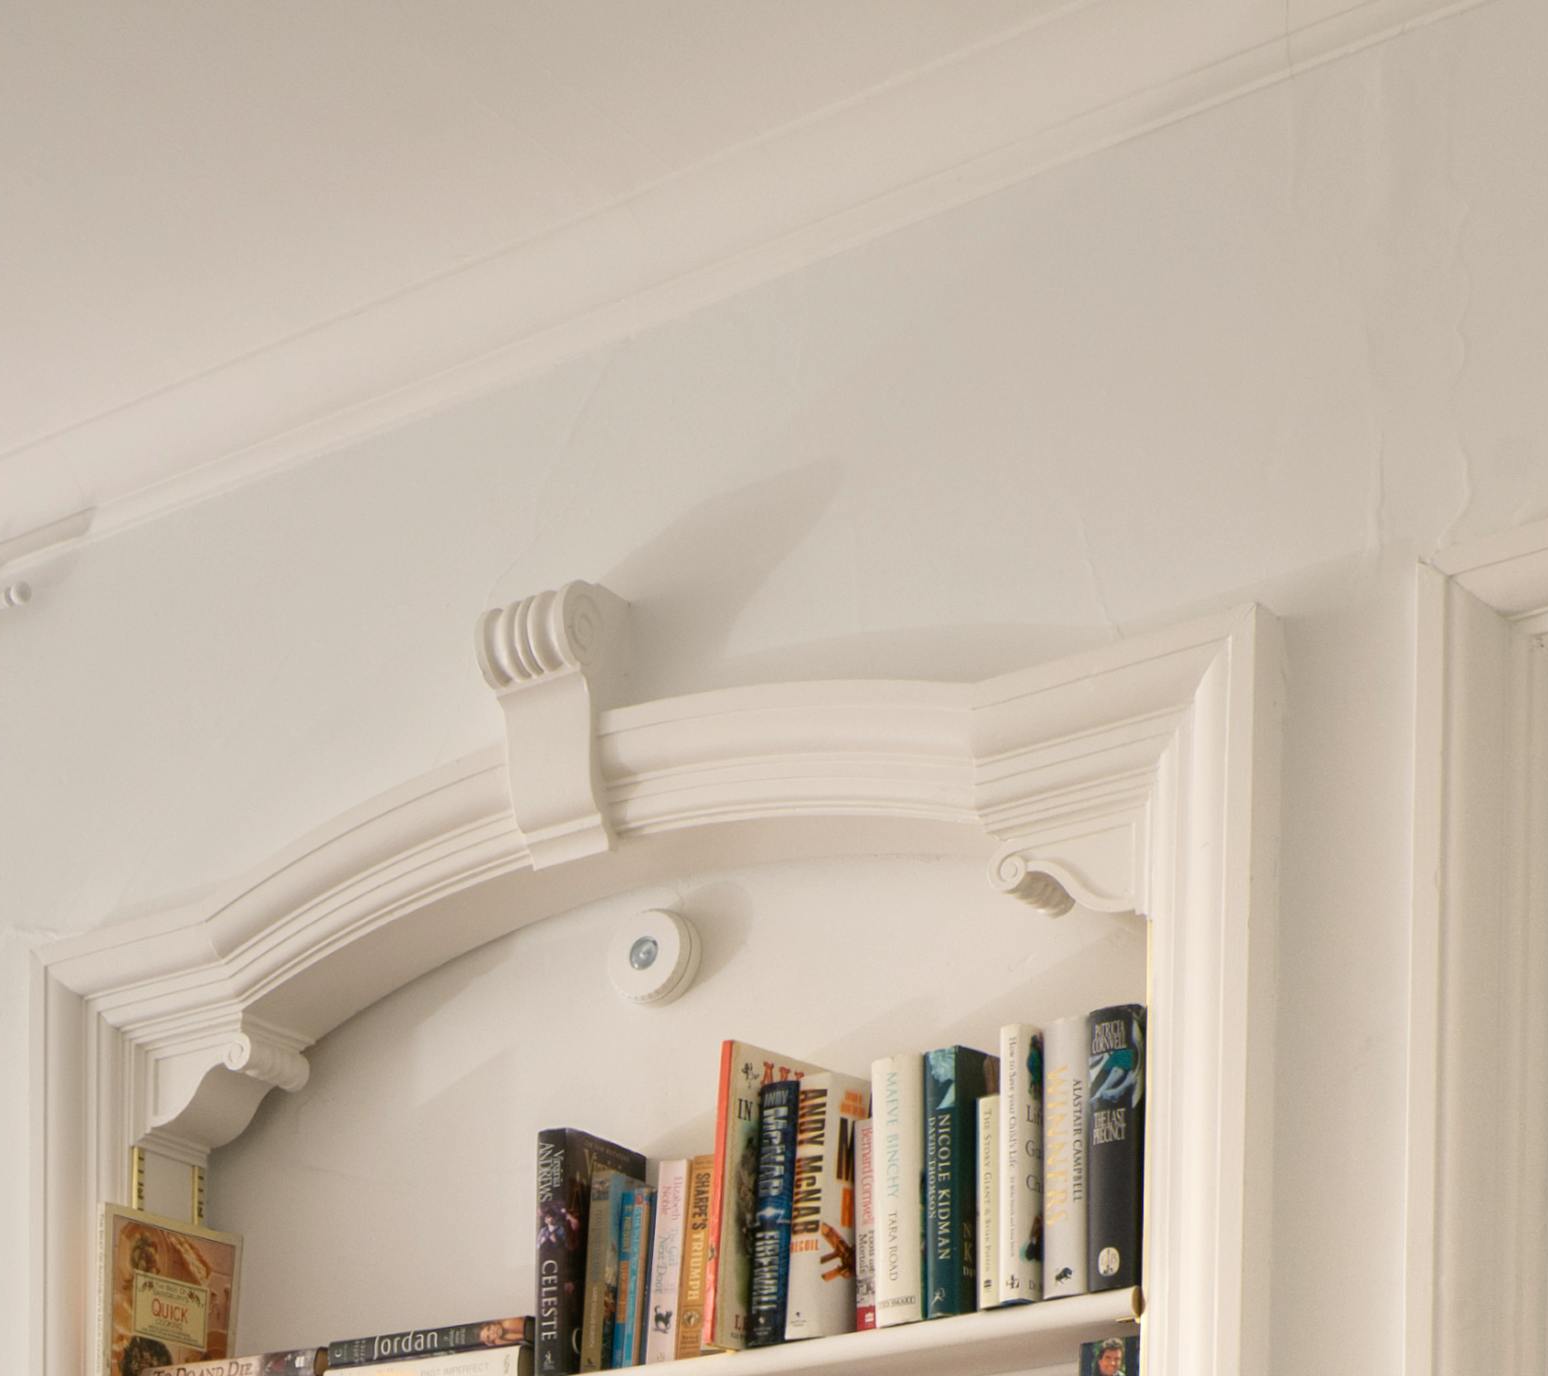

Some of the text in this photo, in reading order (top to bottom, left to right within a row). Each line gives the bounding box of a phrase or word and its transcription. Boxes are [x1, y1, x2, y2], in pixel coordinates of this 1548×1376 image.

[537, 1142, 555, 1202] ANDREWS
[551, 1150, 565, 1187] Virginia
[791, 1088, 828, 1236] ANDY McNAB
[886, 1072, 900, 1281] MAEVE BINCHY TARA ROAD
[928, 1116, 937, 1218] DAVID THOMSON
[937, 1114, 951, 1260] NICOLE KIDMAN
[1046, 1064, 1069, 1227] WINNERS
[1072, 1079, 1083, 1203] ALASTAIR CAMPBELL
[686, 1172, 712, 1301] SHARPE'S TRIUMPH
[152, 1298, 189, 1324] QUICK
[373, 1331, 438, 1359] Jordan
[541, 1260, 558, 1341] CELESTE
